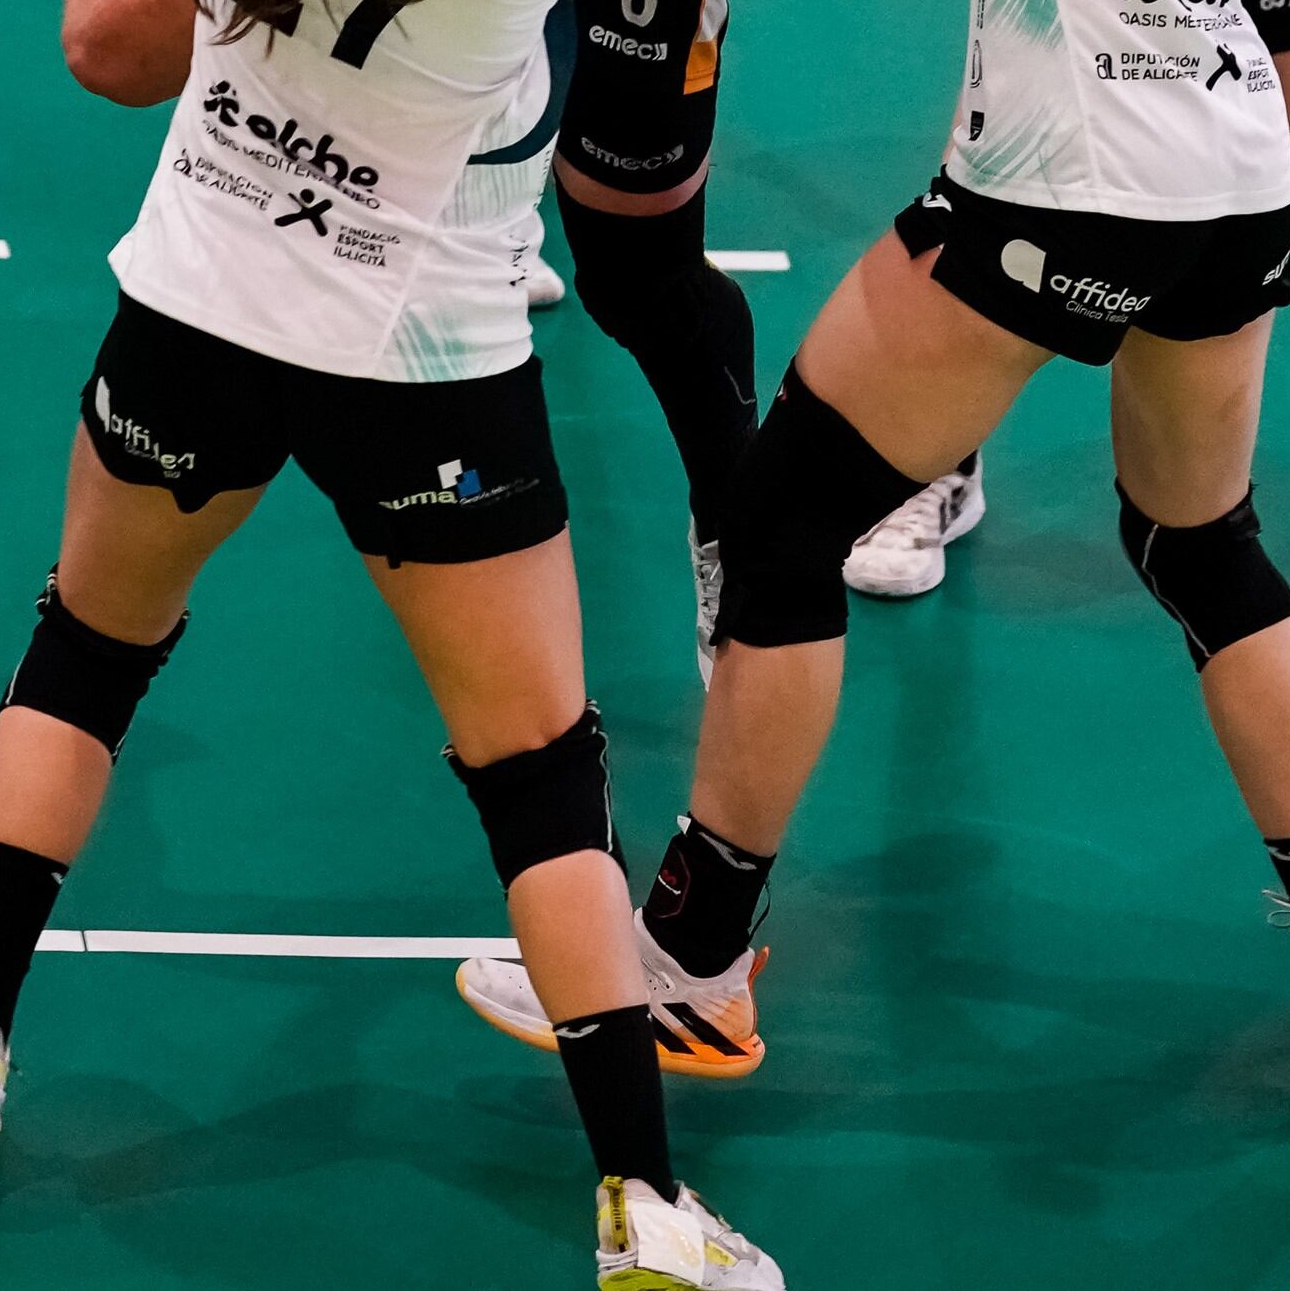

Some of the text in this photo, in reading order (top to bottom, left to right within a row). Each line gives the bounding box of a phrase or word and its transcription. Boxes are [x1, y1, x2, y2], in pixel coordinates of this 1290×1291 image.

[1119, 12, 1167, 28] OASIS
[589, 25, 654, 60] emec
[1122, 69, 1140, 81] DE
[245, 114, 380, 193] elche
[1049, 274, 1152, 312] affidea
